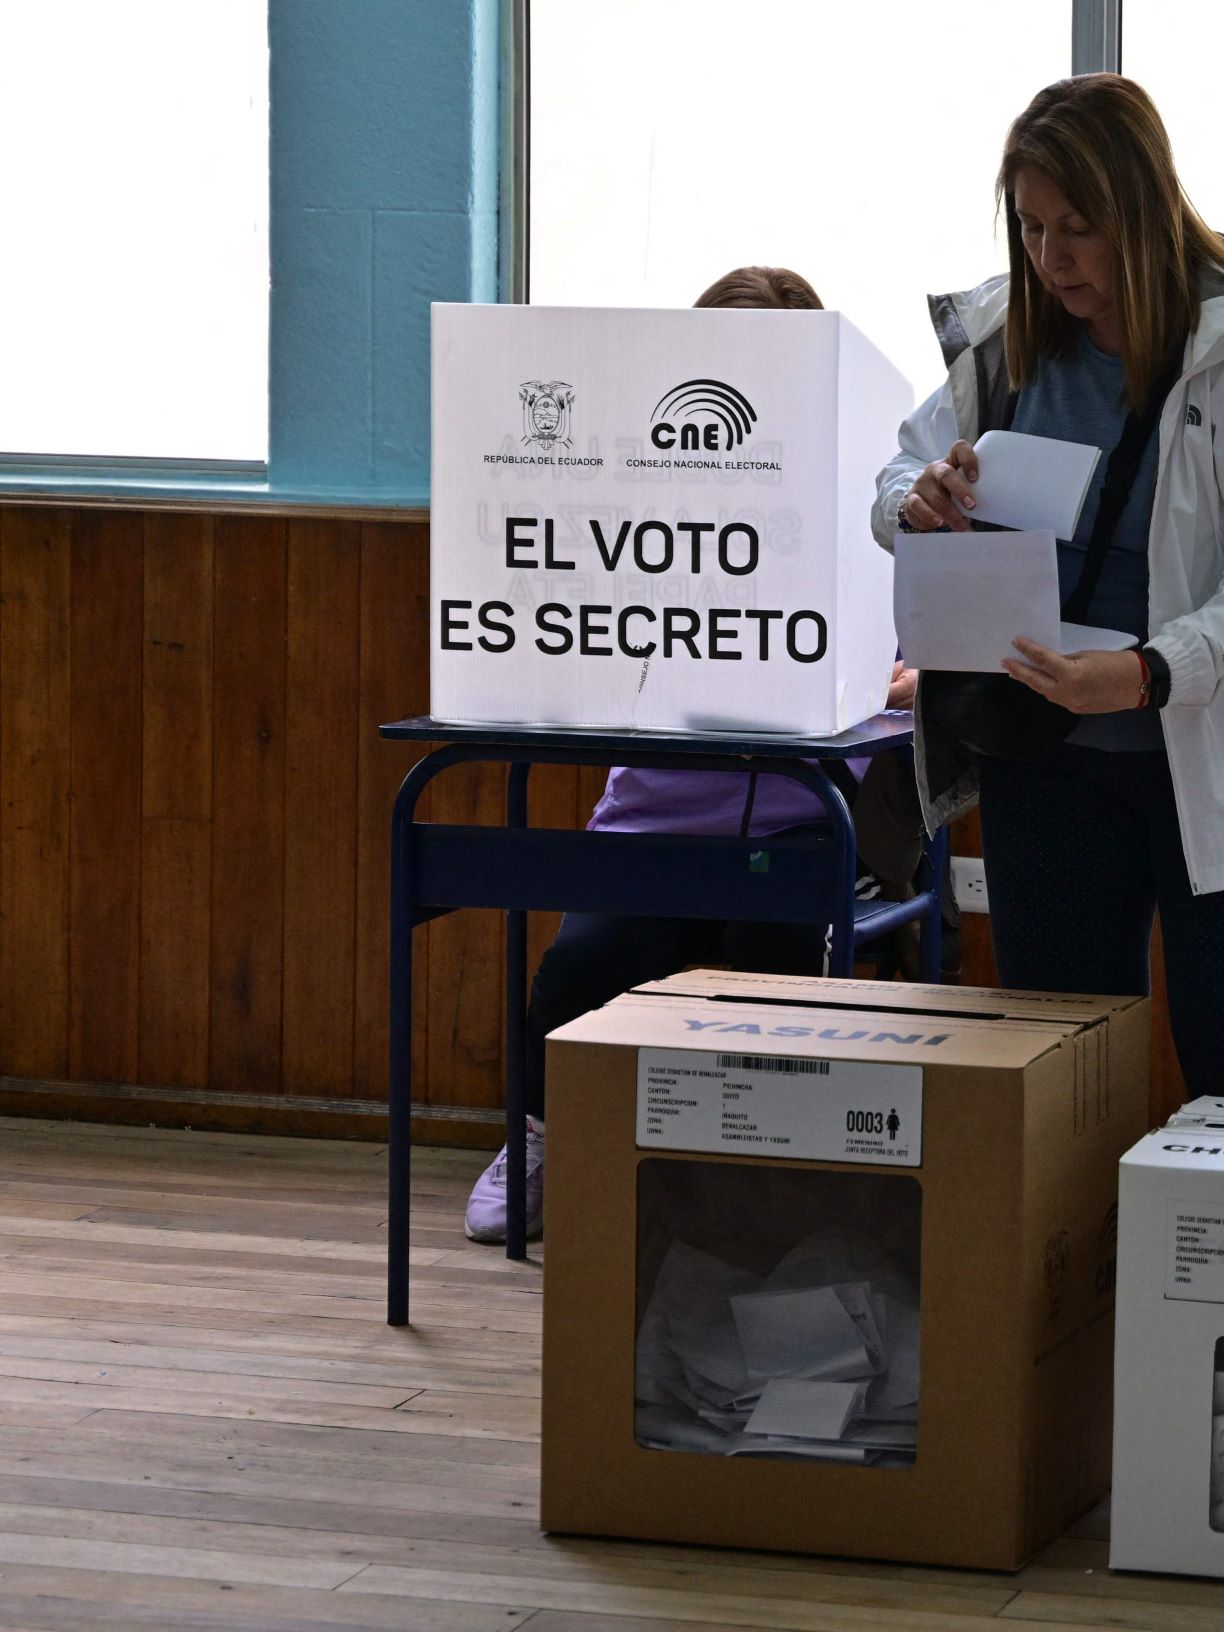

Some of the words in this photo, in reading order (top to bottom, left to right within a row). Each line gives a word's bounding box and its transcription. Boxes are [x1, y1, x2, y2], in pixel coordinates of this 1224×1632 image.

[650, 422, 719, 451] CNE
[483, 453, 536, 466] REPÚBLICA
[537, 456, 555, 466] DEL
[557, 456, 604, 467] ECUADOR
[626, 458, 672, 469] CONSEJO
[674, 460, 723, 470] NACIONAL
[724, 461, 782, 471] ELECTORAL
[505, 517, 576, 571] EL
[589, 519, 759, 576] VOTO
[440, 599, 516, 654] ES
[534, 602, 828, 664] SECRETO
[682, 1018, 955, 1047] YASUNÍ
[722, 1083, 752, 1091] PICHINCHA
[846, 1110, 884, 1134] 0003
